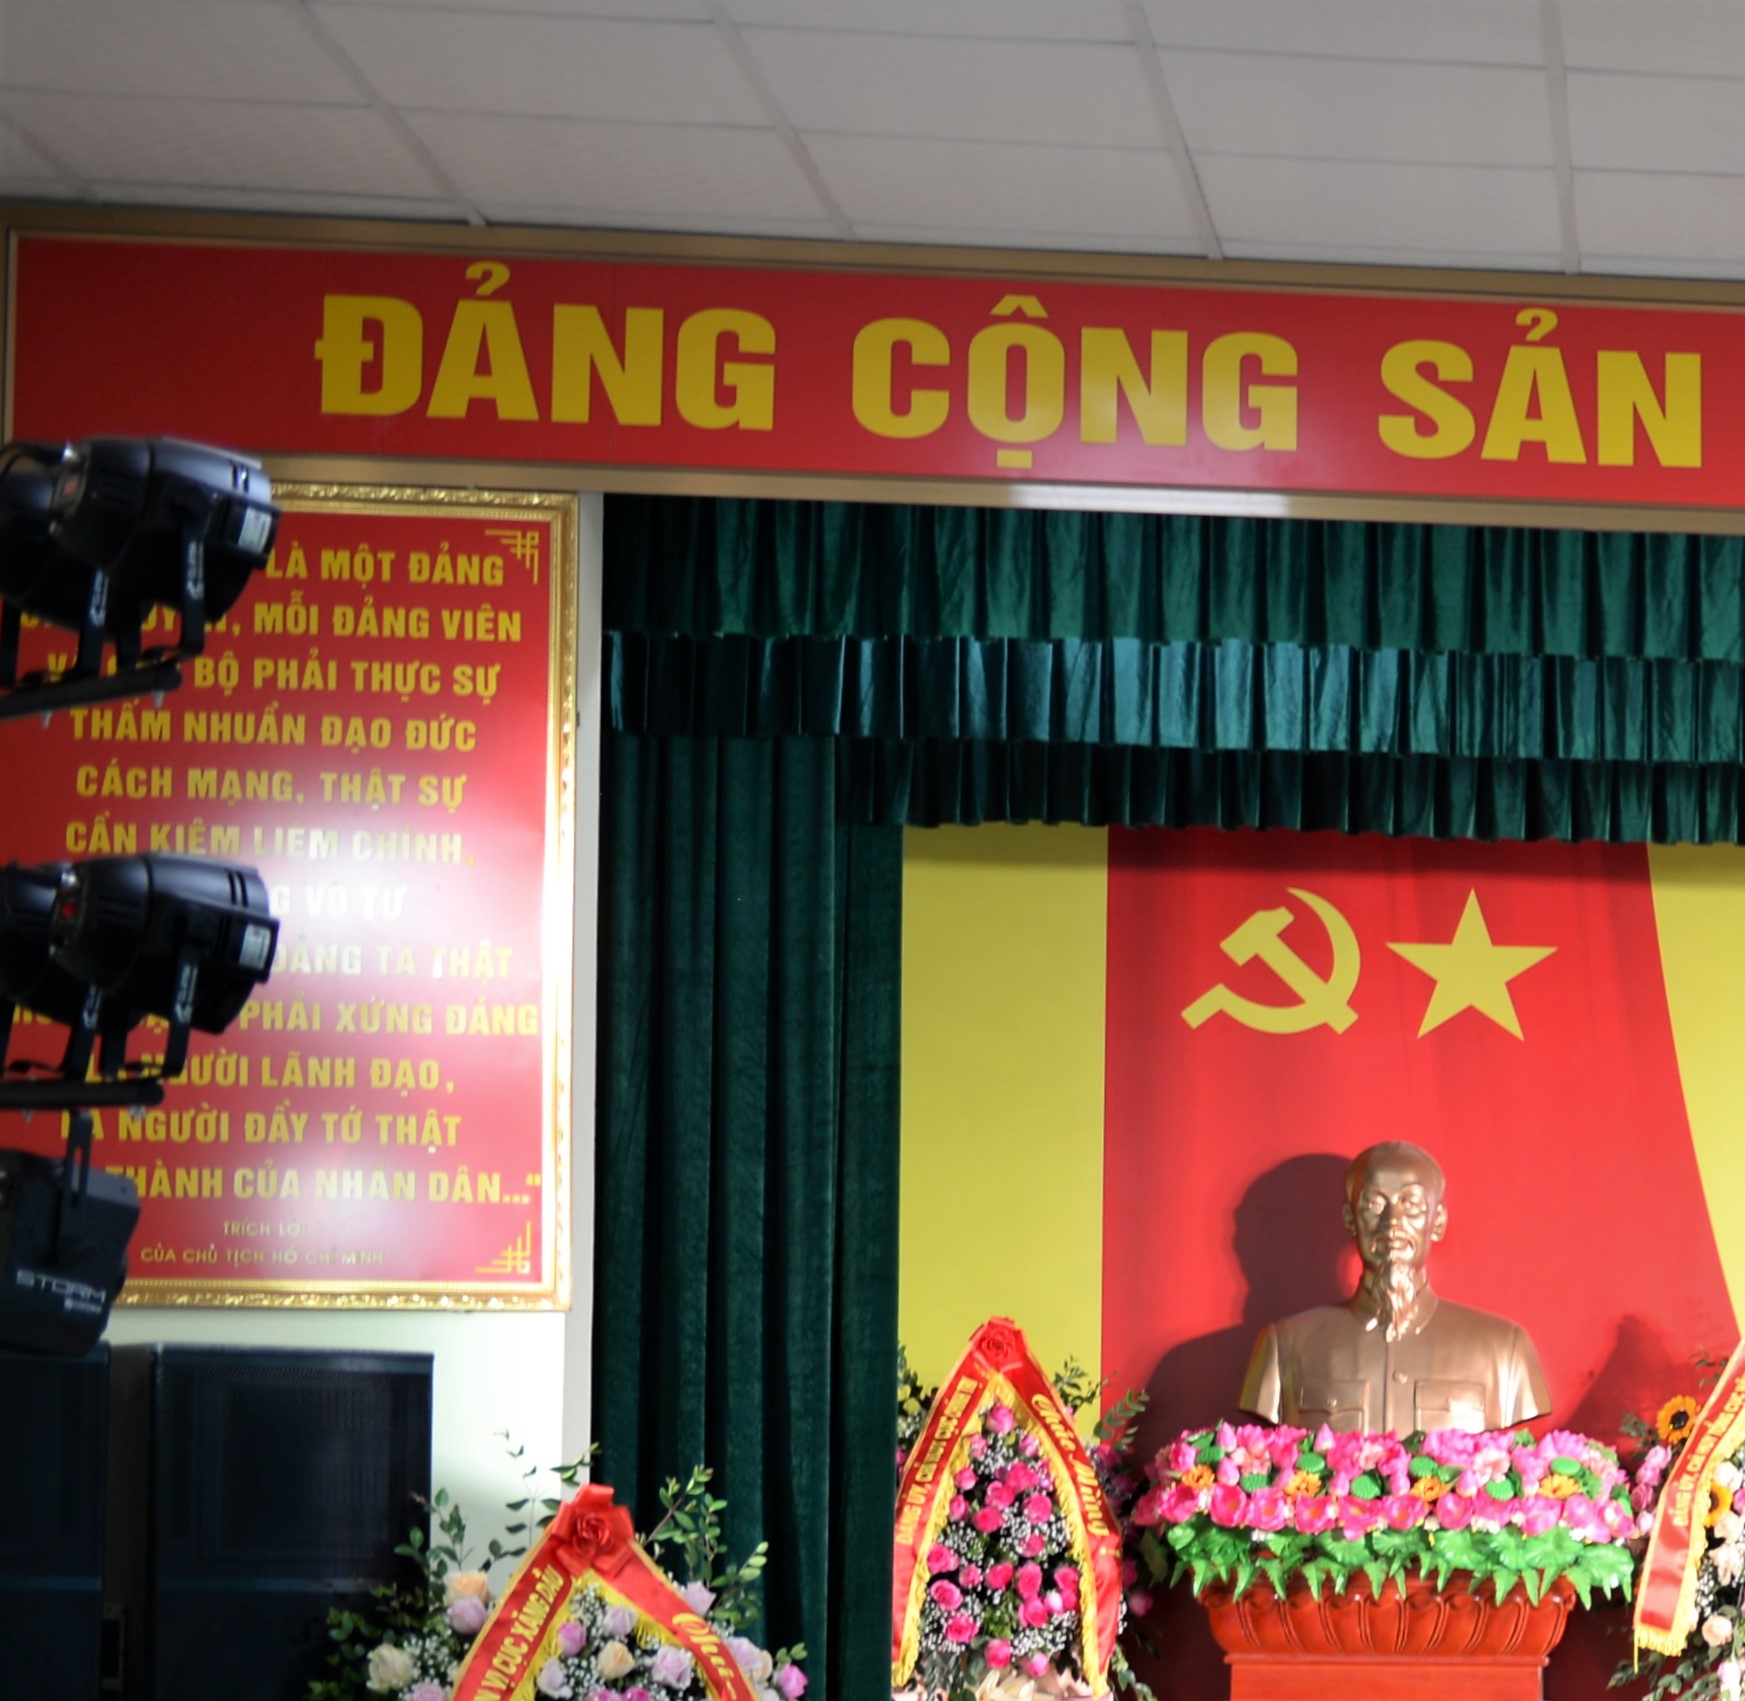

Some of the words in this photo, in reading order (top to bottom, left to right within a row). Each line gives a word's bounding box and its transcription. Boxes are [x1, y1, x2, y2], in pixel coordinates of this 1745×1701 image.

[315, 262, 776, 430] ĐẢNG
[851, 294, 1298, 469] CỘNG
[1378, 307, 1702, 469] SẢN
[320, 545, 396, 589] MỘT
[409, 542, 504, 586] ĐẢNG
[254, 589, 319, 636] MỖI
[333, 596, 430, 641] ĐẢNG
[442, 603, 522, 642] VIÊN
[194, 651, 239, 695] BỘ
[253, 649, 337, 693] PHẢI
[352, 660, 442, 703] THỰC
[453, 664, 500, 705] SỰ
[321, 714, 392, 755] ĐẠO
[406, 714, 477, 752] ĐỨC
[77, 758, 172, 798] CÁCH
[187, 768, 305, 806] MẠNG,
[320, 766, 405, 811] THẬT
[418, 773, 467, 814] SỰ
[66, 811, 138, 854] CẦN
[375, 947, 416, 975] TA
[430, 939, 512, 984] THẬT
[240, 991, 322, 1032] PHẢI
[335, 996, 432, 1034] XỨNG
[445, 996, 539, 1036] ĐÁNG
[262, 1050, 355, 1088] LÃNH
[370, 1056, 455, 1098] ĐẠO,
[119, 1103, 229, 1143] NGƯỜI
[322, 1108, 363, 1145] TỚ
[376, 1111, 461, 1154] THẬT
[233, 1156, 301, 1199] CỦA
[315, 1165, 417, 1203] NHÂN
[16, 1269, 106, 1304] STORM
